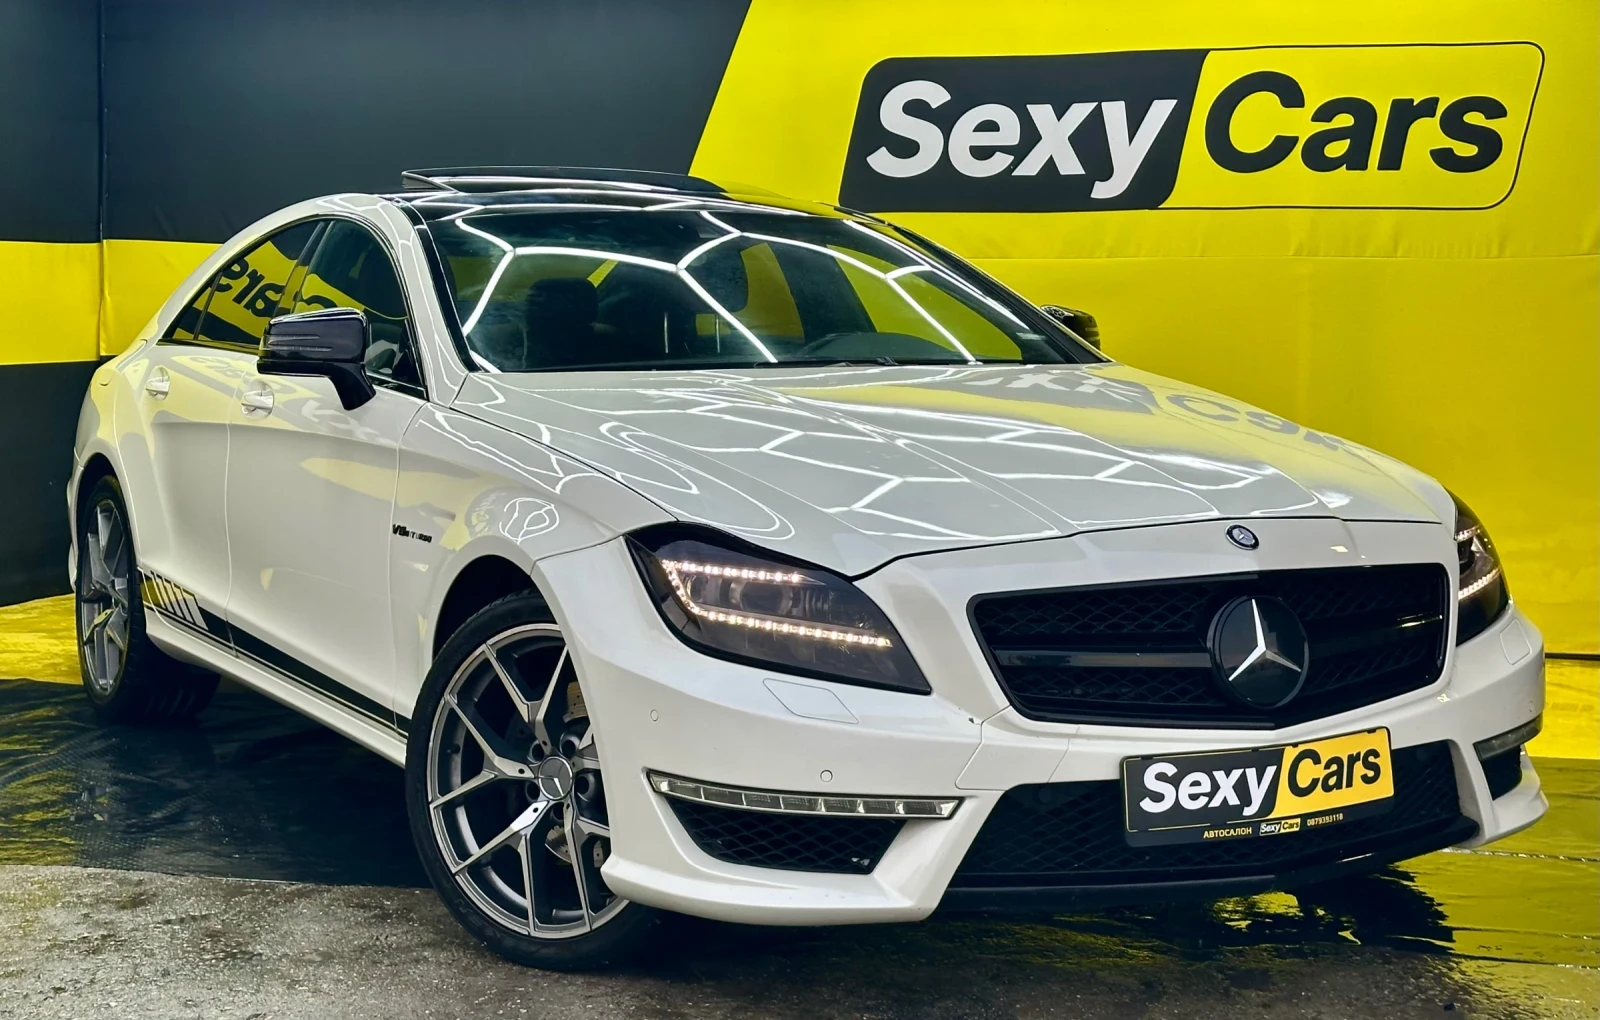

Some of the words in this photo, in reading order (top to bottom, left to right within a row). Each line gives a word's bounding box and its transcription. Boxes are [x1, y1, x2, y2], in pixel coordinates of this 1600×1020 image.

[865, 79, 1178, 200] Sexy
[1204, 70, 1508, 174] Cars
[1139, 762, 1277, 816] Sexy
[1287, 748, 1381, 798] Cars
[1203, 826, 1252, 839] АВТОСАЛОН
[1260, 822, 1280, 833] Sexy
[1282, 821, 1299, 830] Cars
[1306, 813, 1344, 827] 0879393118
